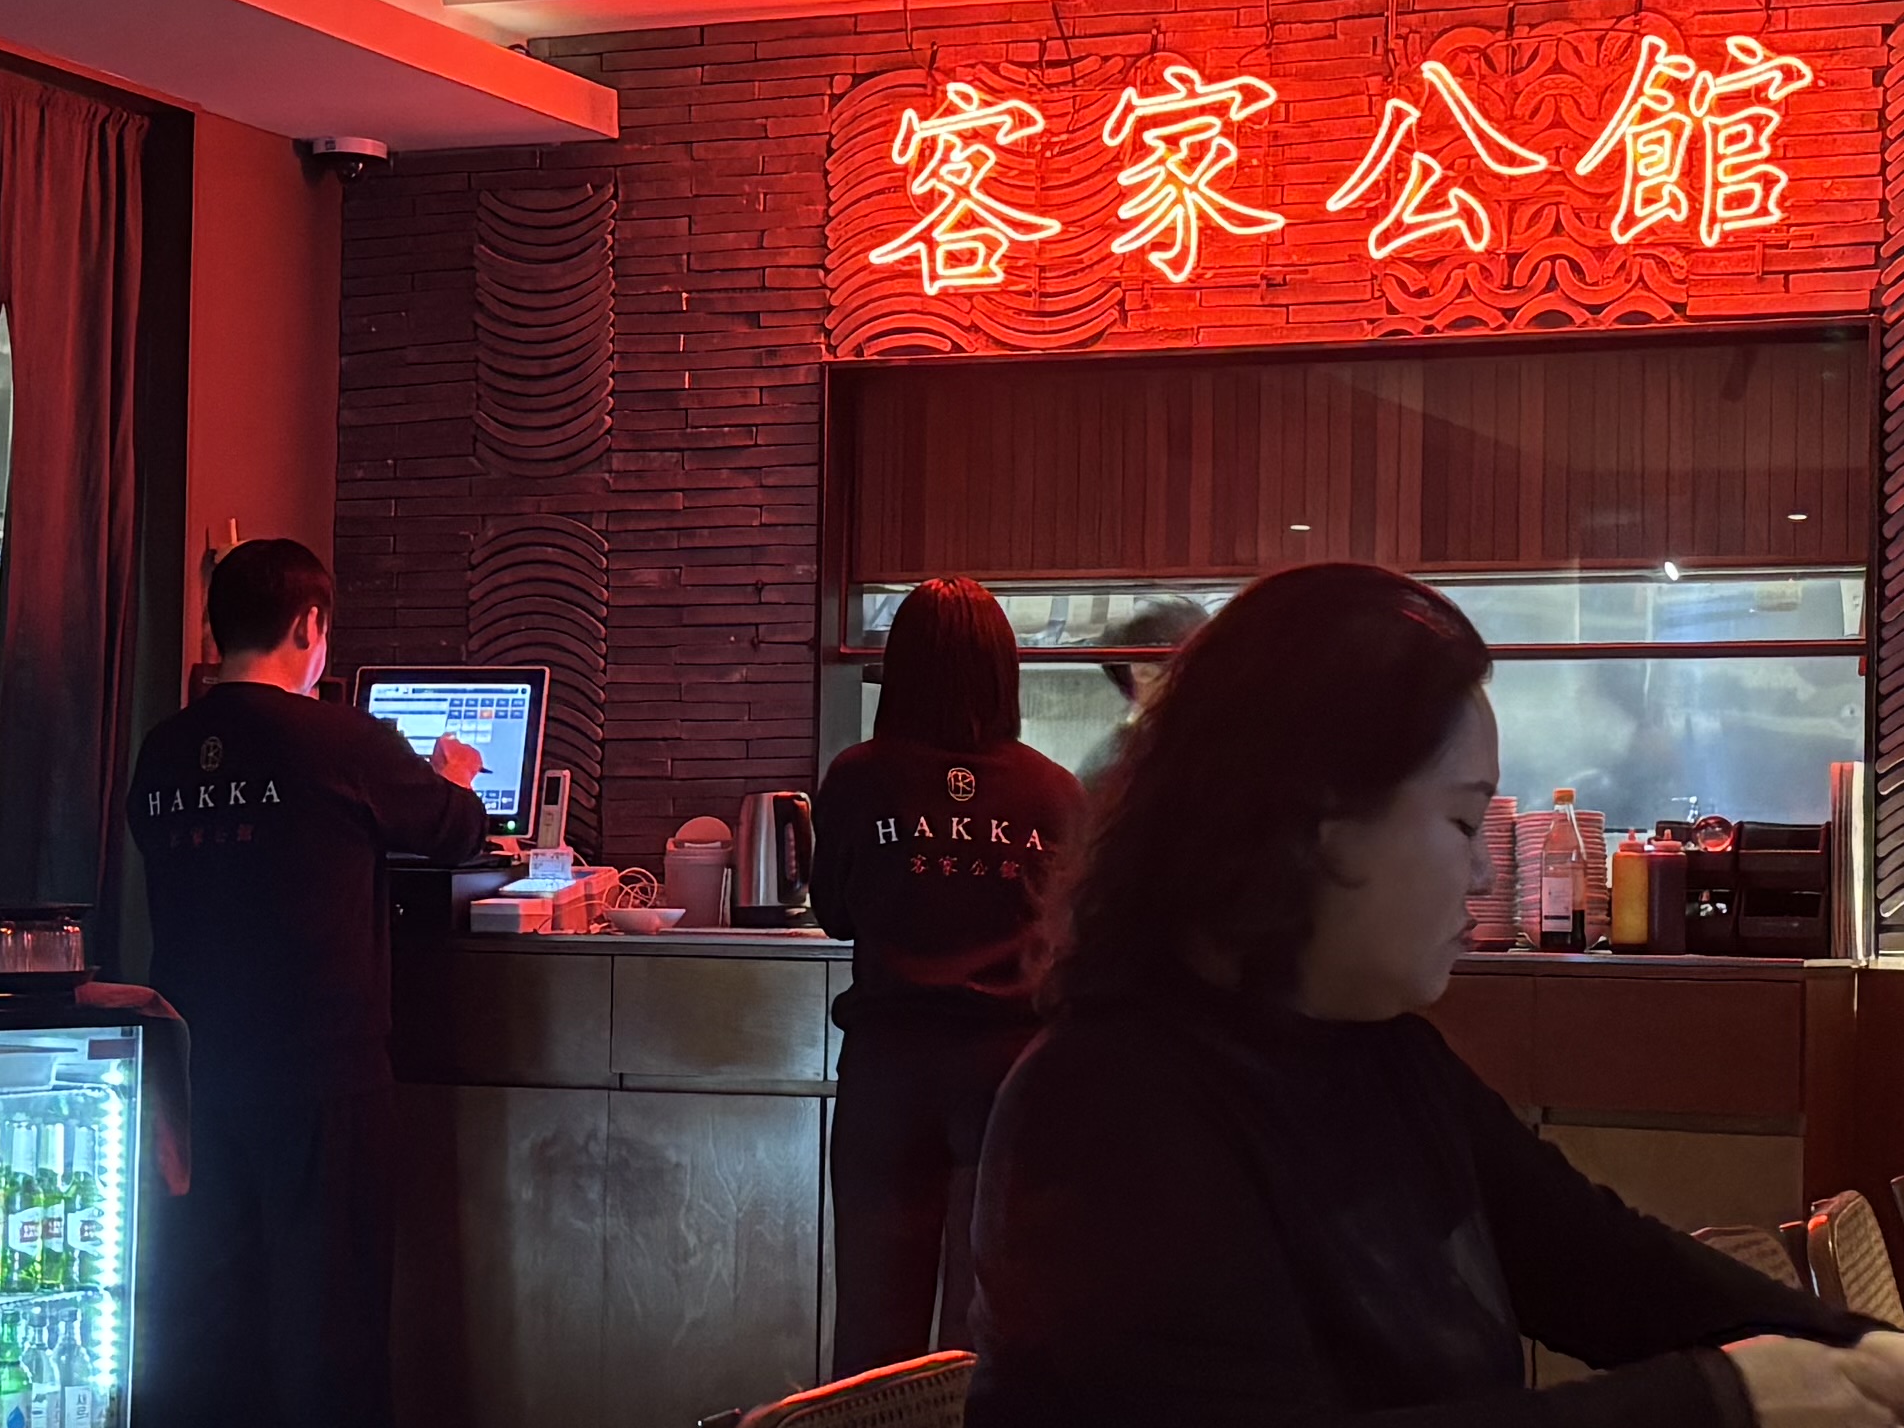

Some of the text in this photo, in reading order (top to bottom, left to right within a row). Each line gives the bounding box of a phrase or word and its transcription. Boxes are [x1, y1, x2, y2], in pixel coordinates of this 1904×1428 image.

[869, 34, 1813, 296] 客家公館
[148, 780, 281, 816] HAKKA
[876, 816, 1044, 851] HAKKA
